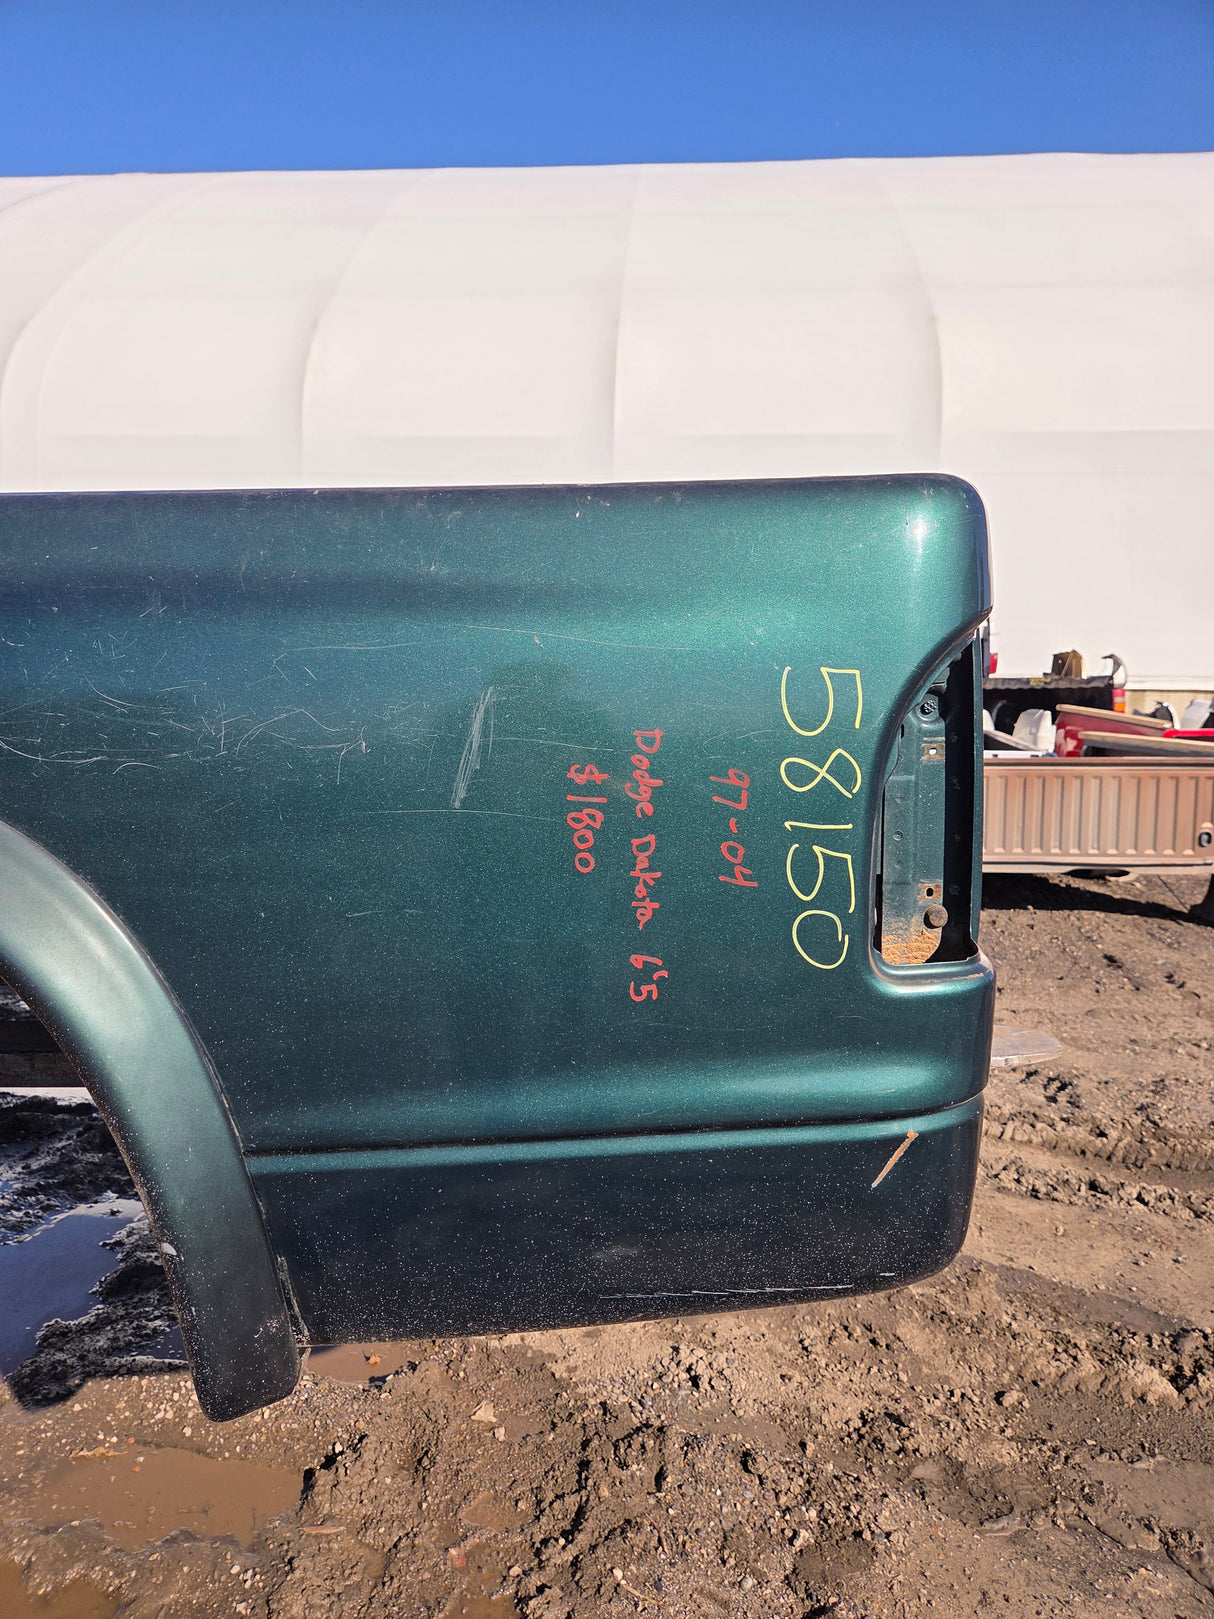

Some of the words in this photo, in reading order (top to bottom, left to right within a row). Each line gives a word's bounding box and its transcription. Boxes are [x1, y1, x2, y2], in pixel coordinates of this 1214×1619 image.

[566, 763, 609, 874] $1800
[625, 728, 664, 818] Dodge
[710, 768, 759, 888] 97-04
[779, 665, 863, 970] 58150
[630, 834, 662, 930] Dakota
